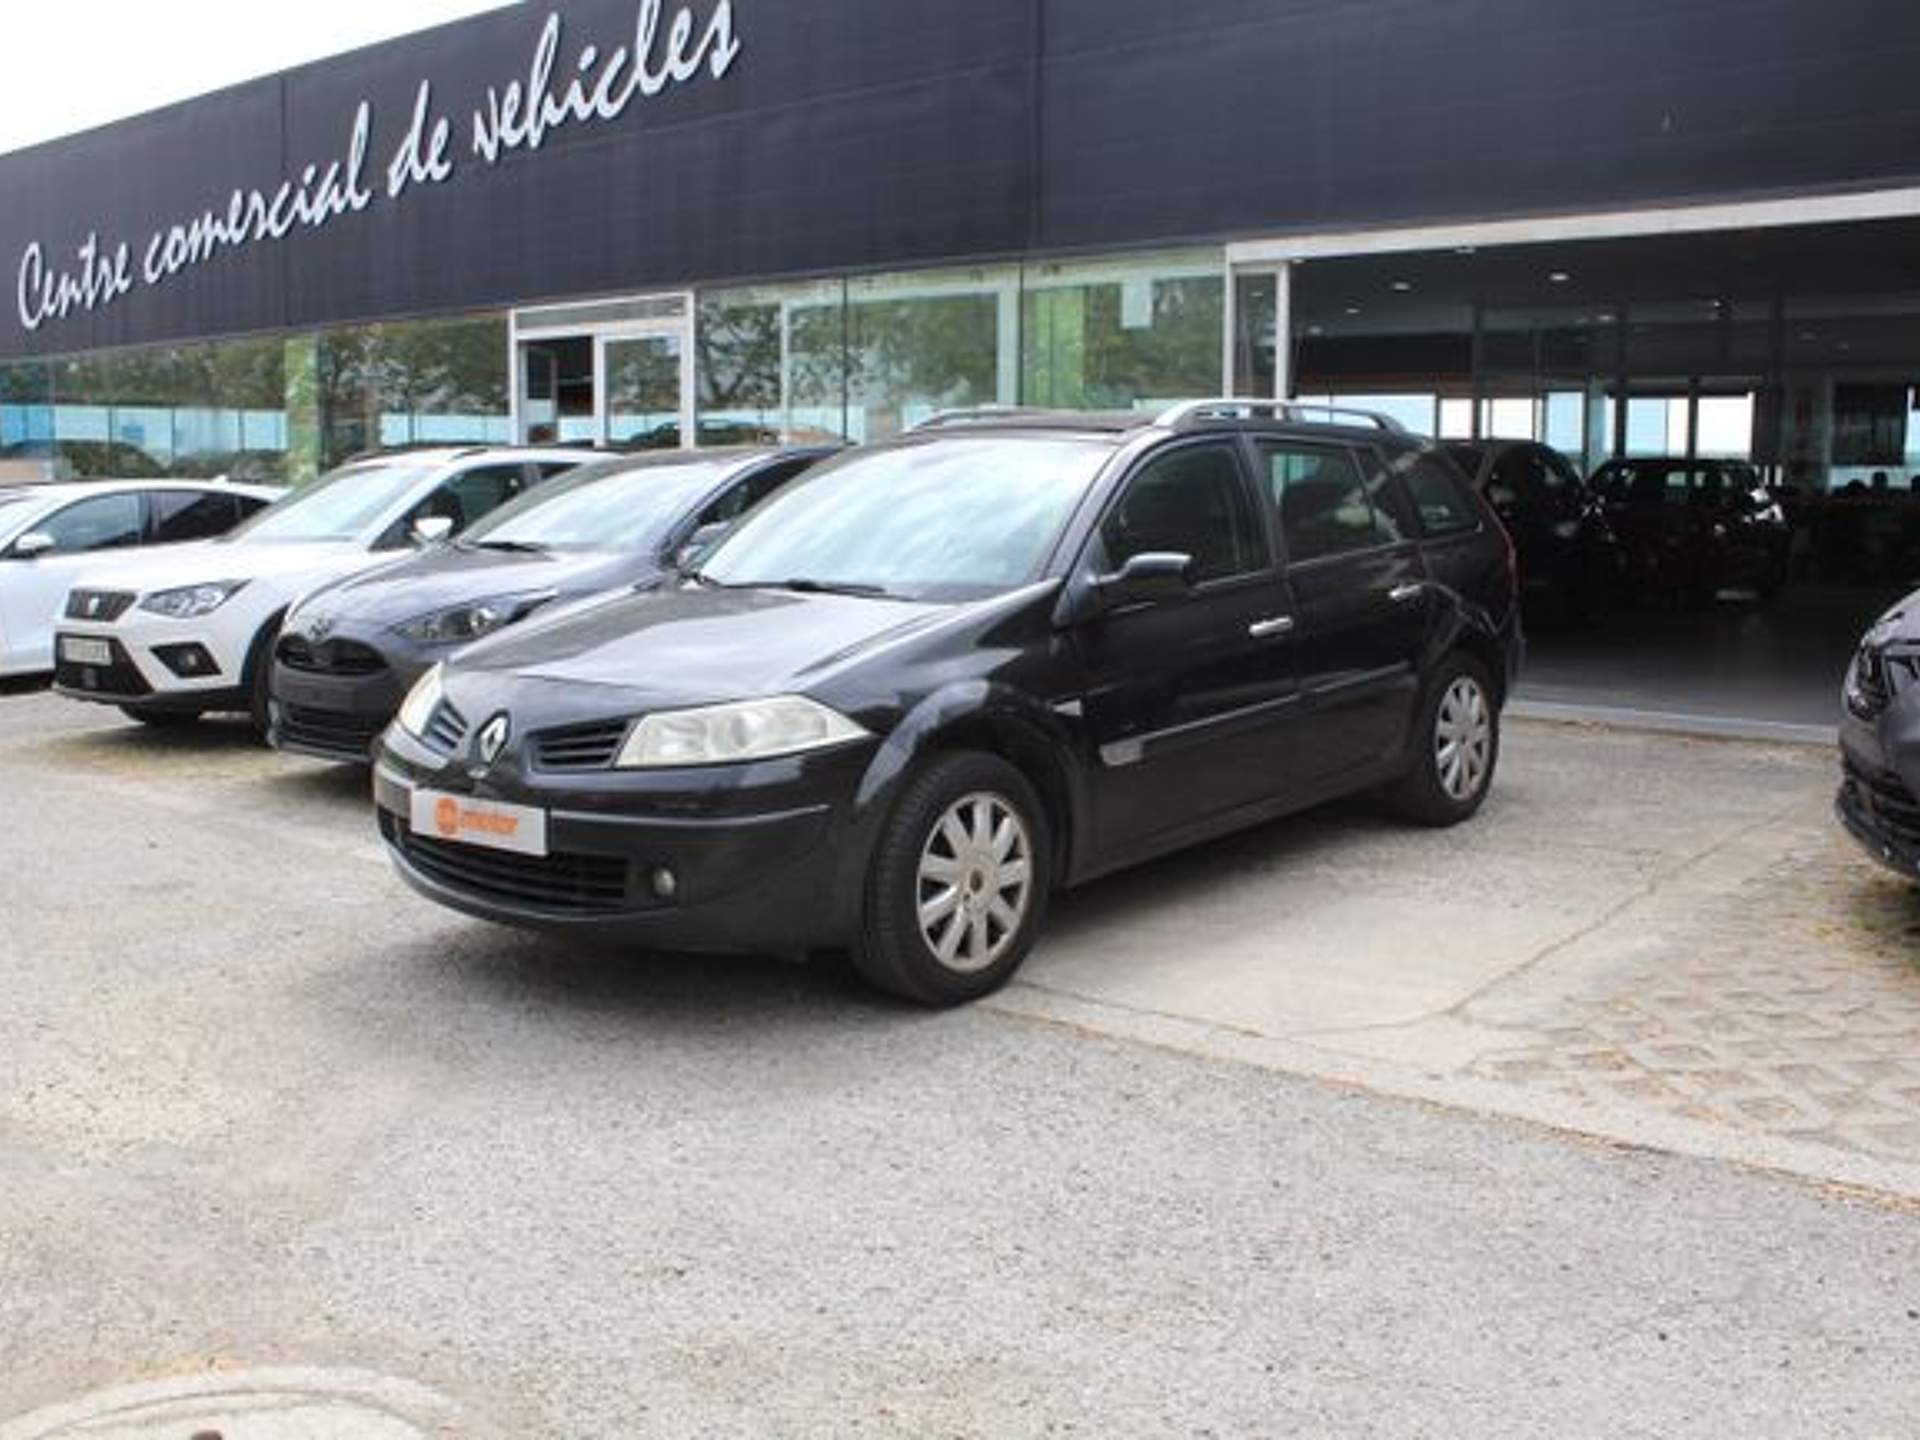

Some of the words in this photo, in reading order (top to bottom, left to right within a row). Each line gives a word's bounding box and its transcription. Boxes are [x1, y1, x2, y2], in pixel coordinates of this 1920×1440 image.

[17, 231, 132, 331] Centre
[143, 100, 372, 285] comercial
[387, 78, 452, 199] de
[472, 0, 740, 162] vehicles
